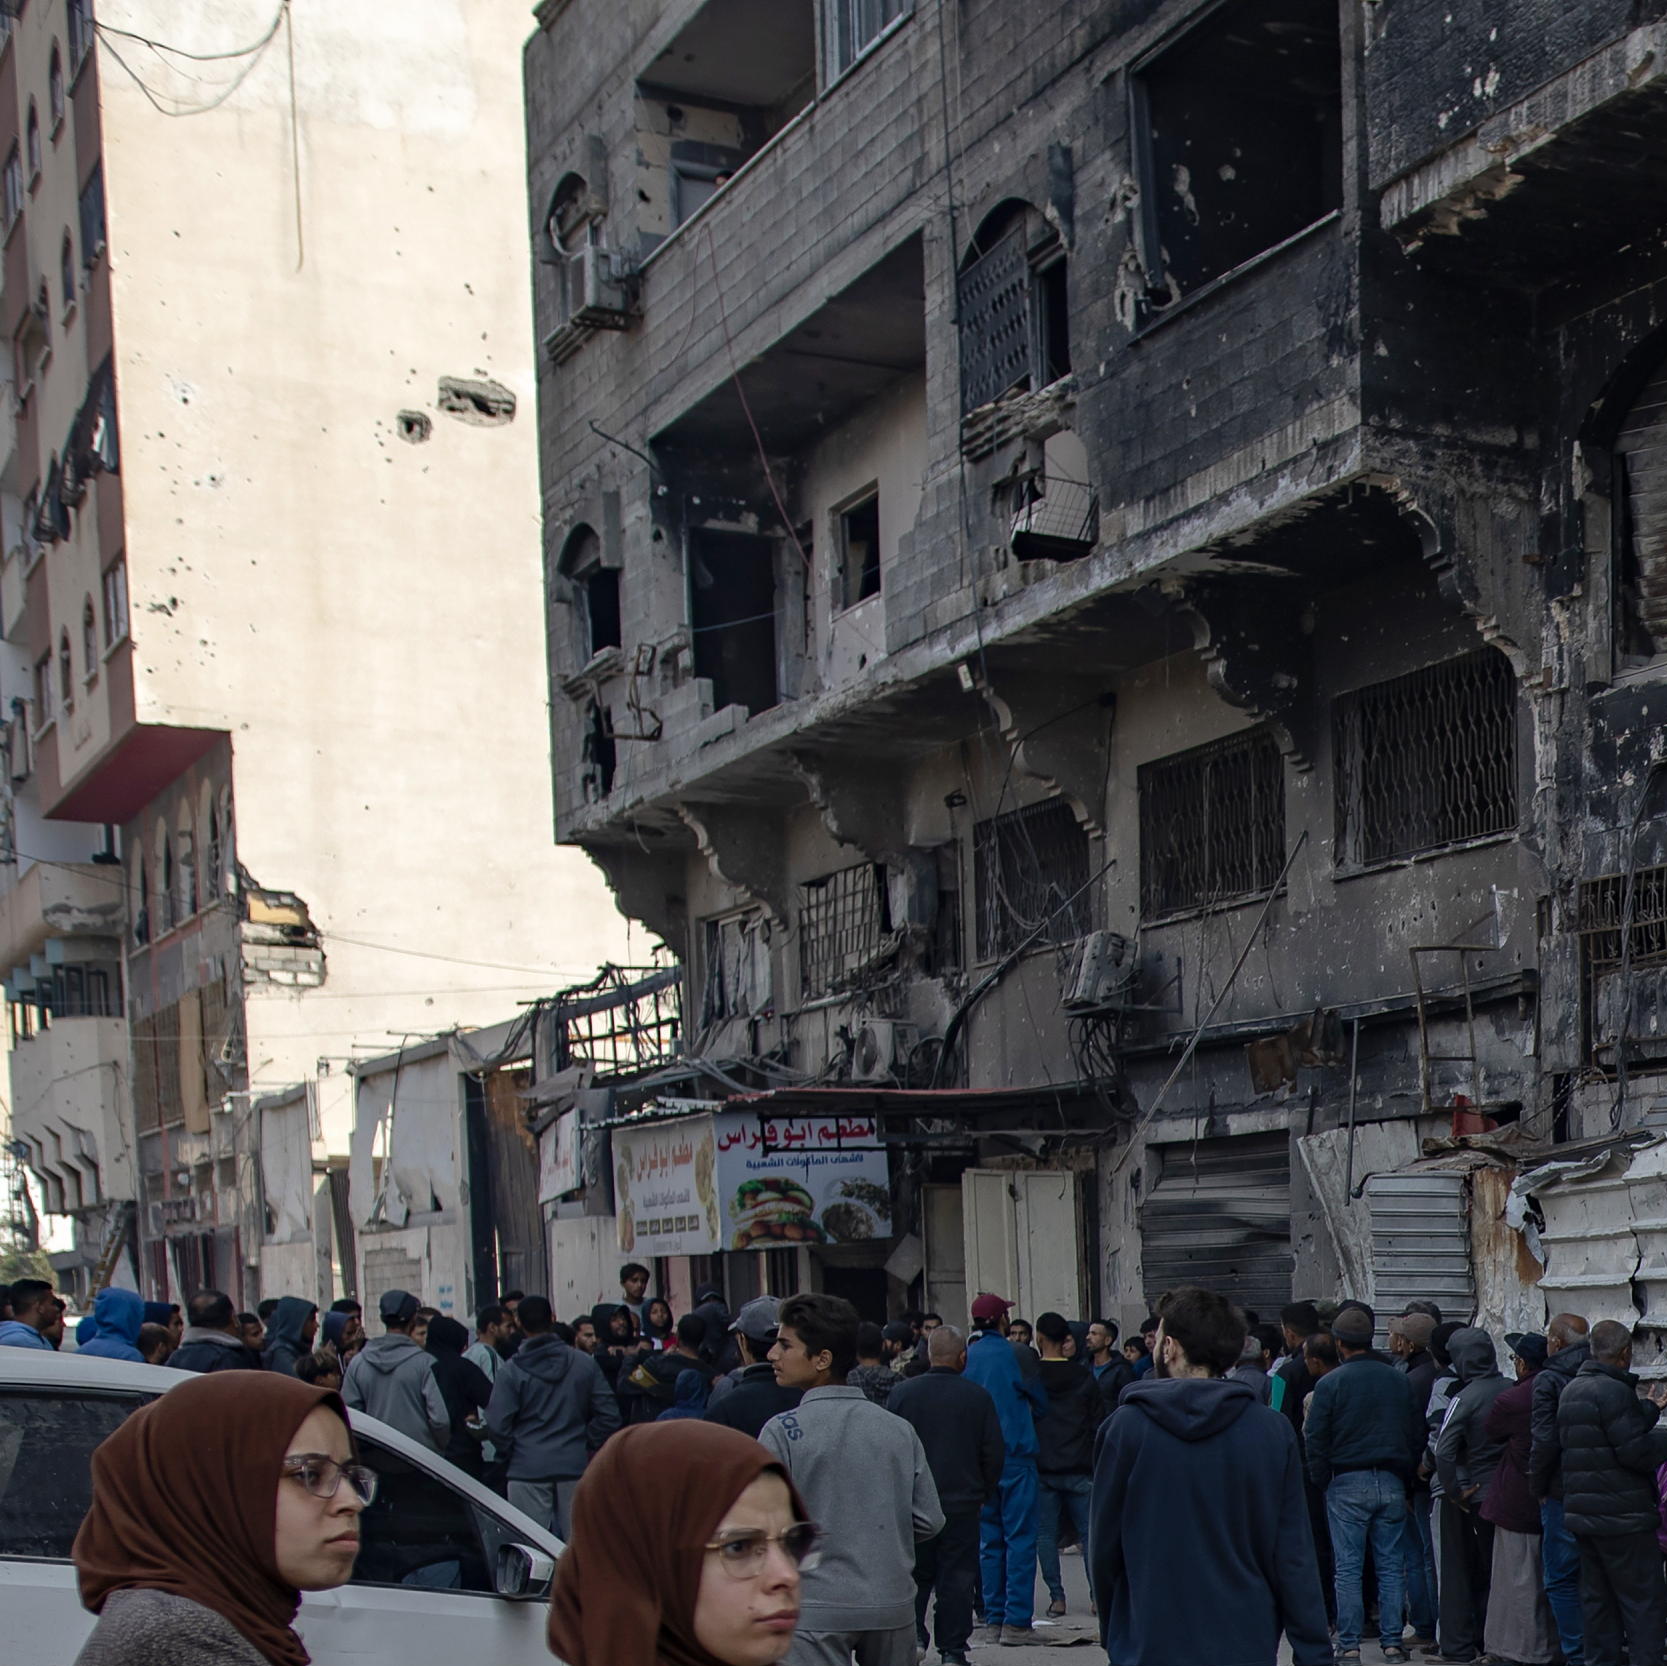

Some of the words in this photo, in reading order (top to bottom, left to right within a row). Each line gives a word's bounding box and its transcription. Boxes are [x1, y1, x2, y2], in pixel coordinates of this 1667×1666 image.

[718, 1120, 777, 1150] فراس
[784, 1120, 811, 1148] ابو
[817, 1116, 872, 1145] مطعم
